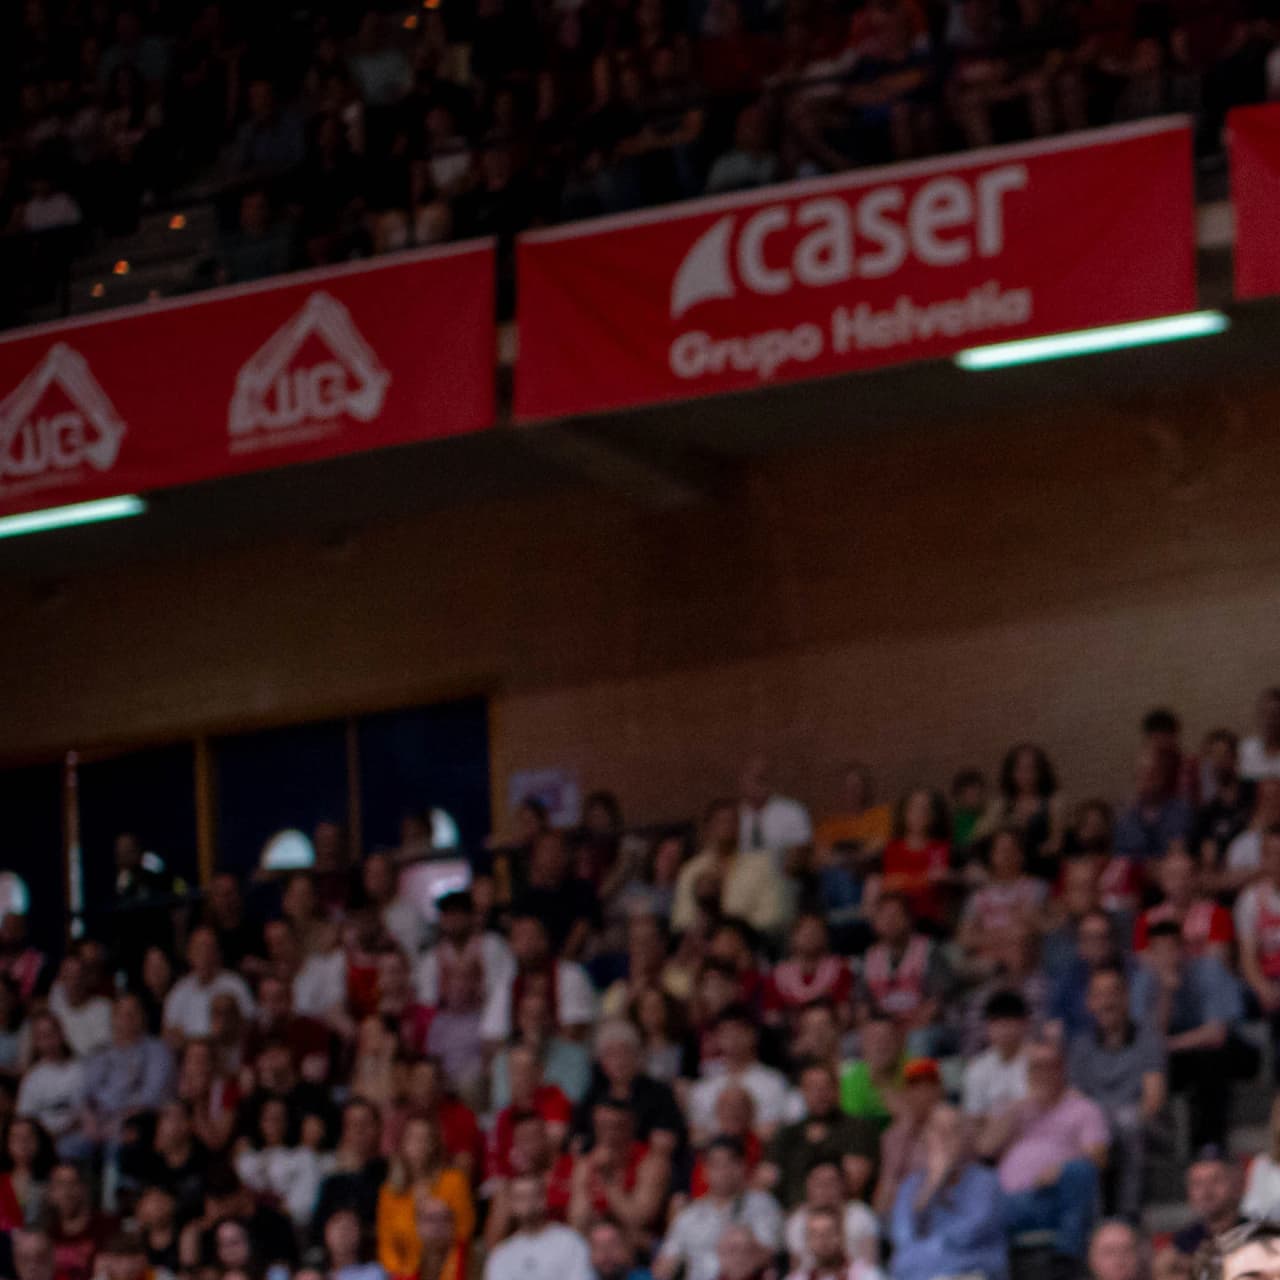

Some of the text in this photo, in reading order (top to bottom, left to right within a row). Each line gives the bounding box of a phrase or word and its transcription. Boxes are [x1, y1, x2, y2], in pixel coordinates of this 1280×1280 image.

[737, 165, 1028, 295] caser
[669, 280, 1033, 379] Grupo Helvetia
